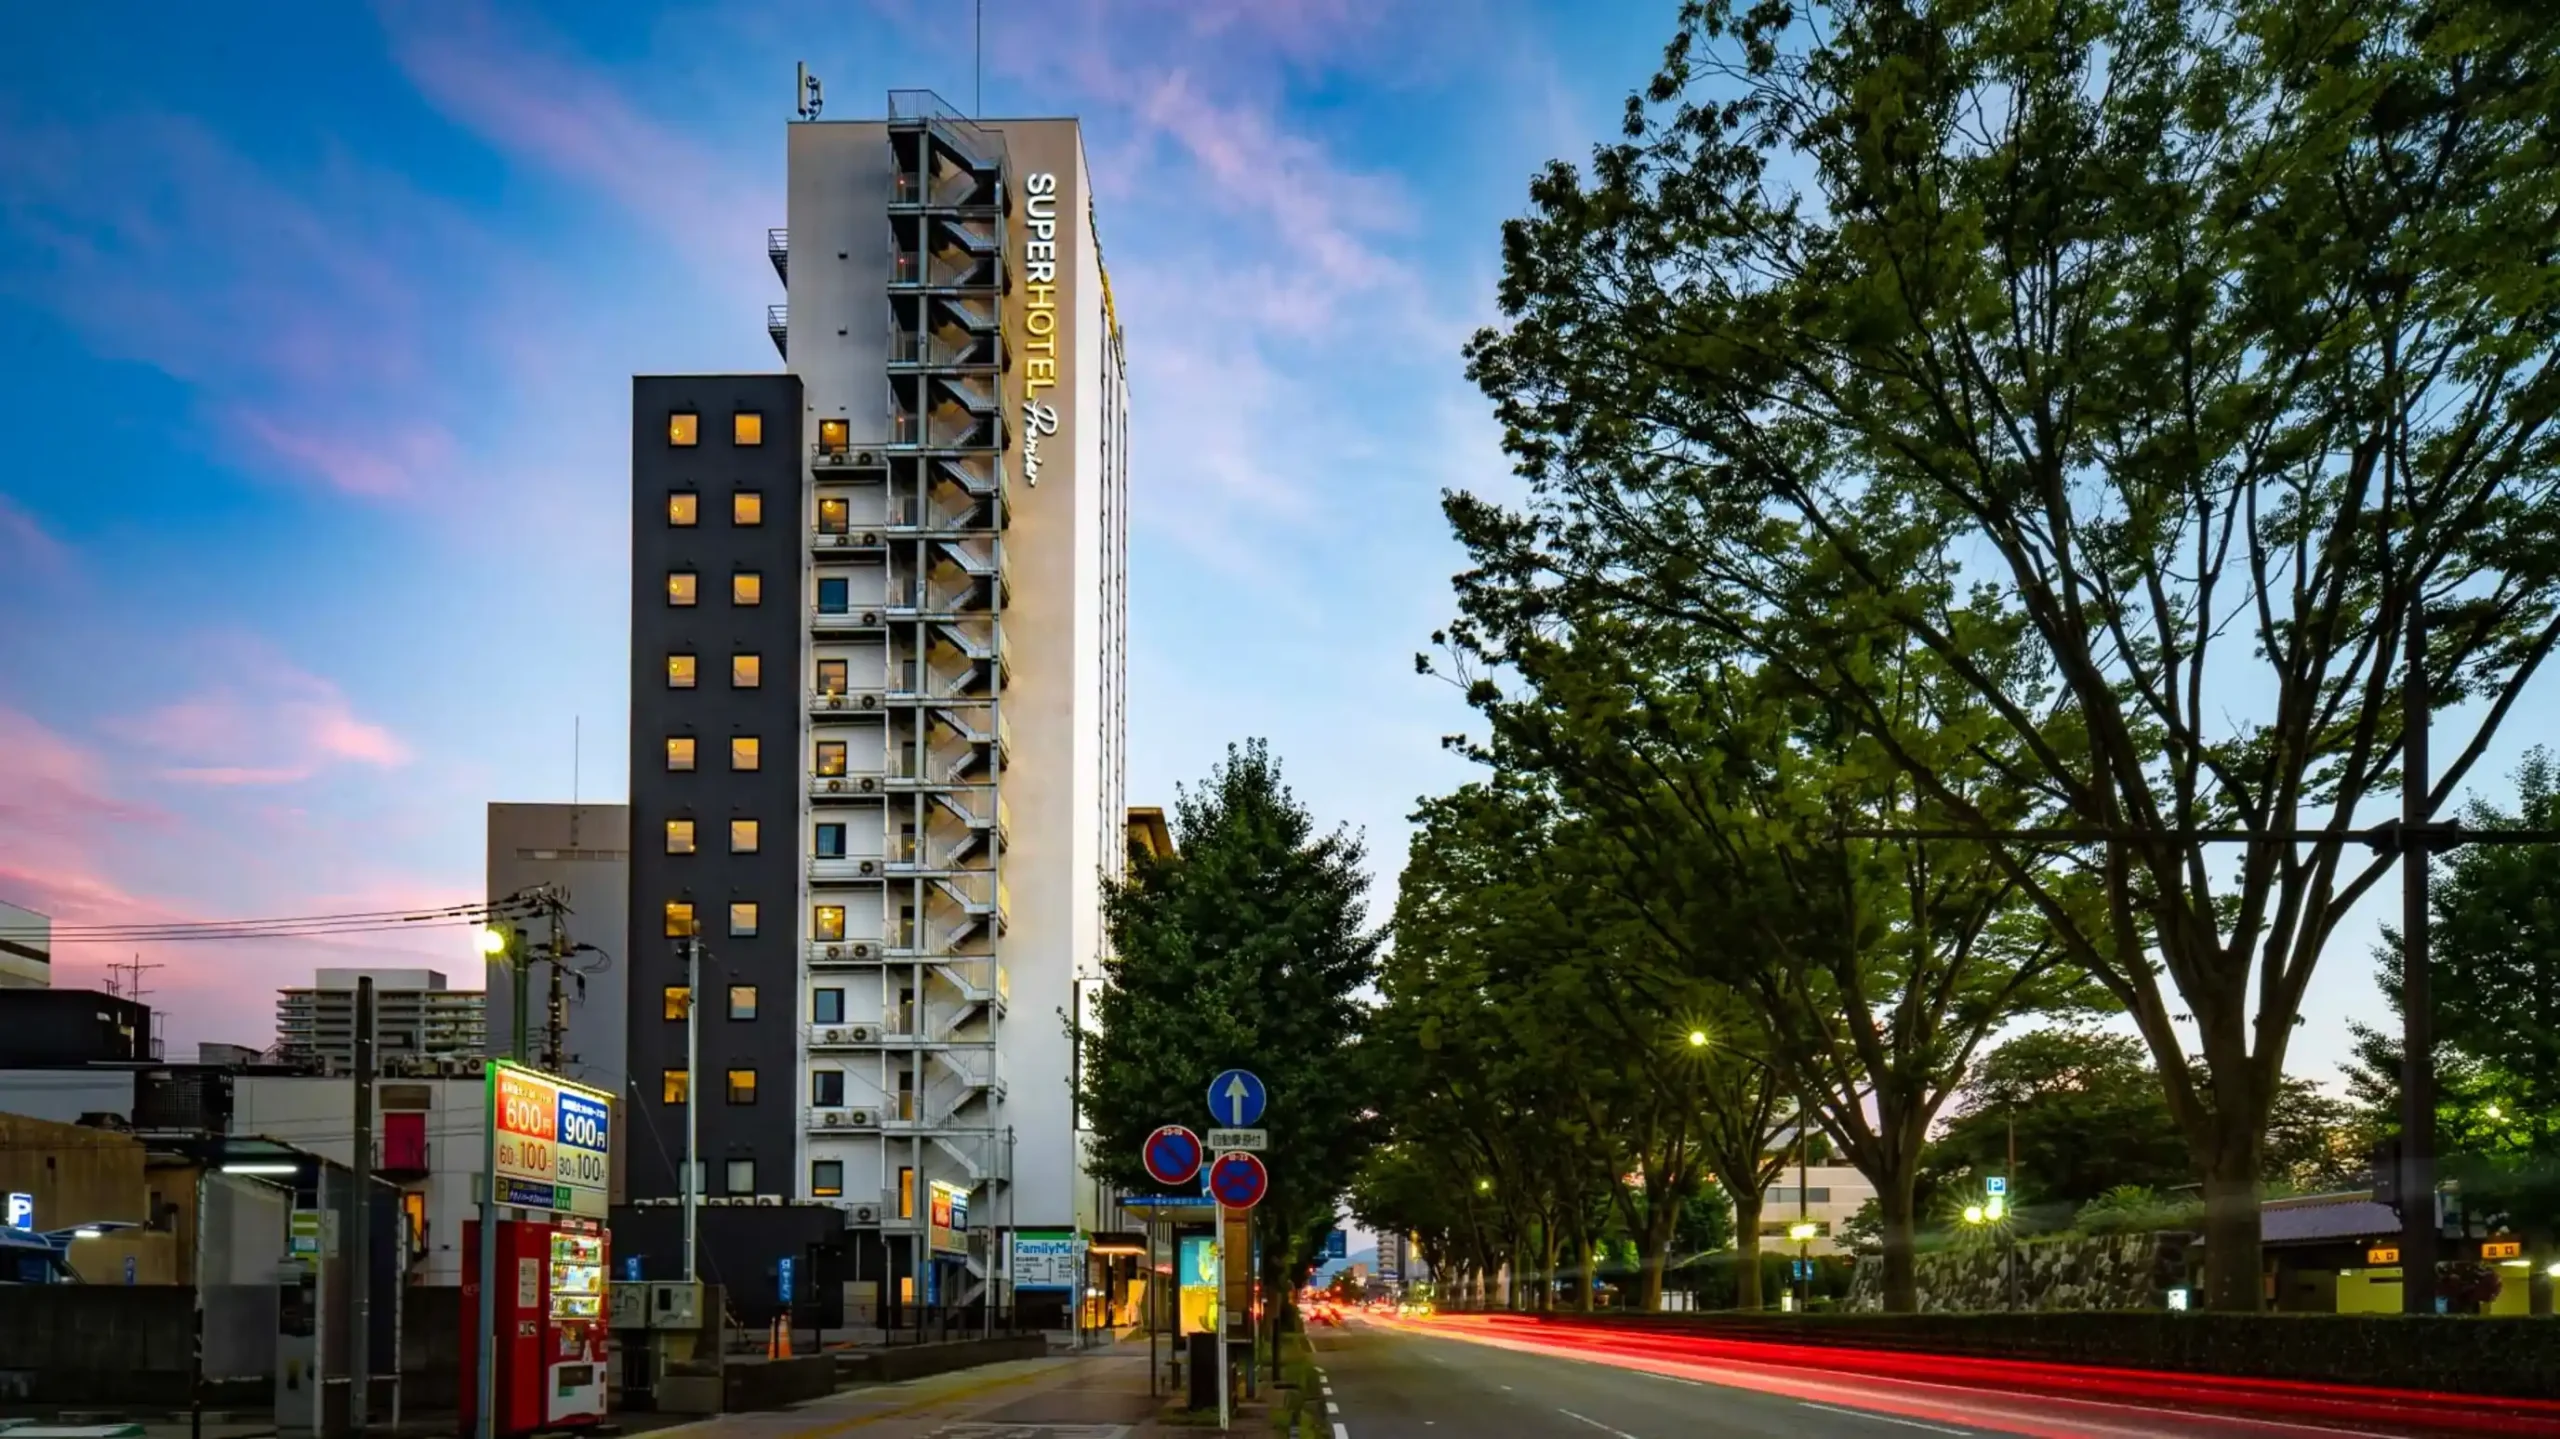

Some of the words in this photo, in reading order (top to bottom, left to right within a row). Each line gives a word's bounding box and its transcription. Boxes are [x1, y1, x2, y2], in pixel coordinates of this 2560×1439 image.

[1023, 398, 1058, 486] Premier
[1991, 1178, 2002, 1191] P
[11, 1199, 31, 1225] P
[1015, 1242, 1084, 1254] FamilyMa
